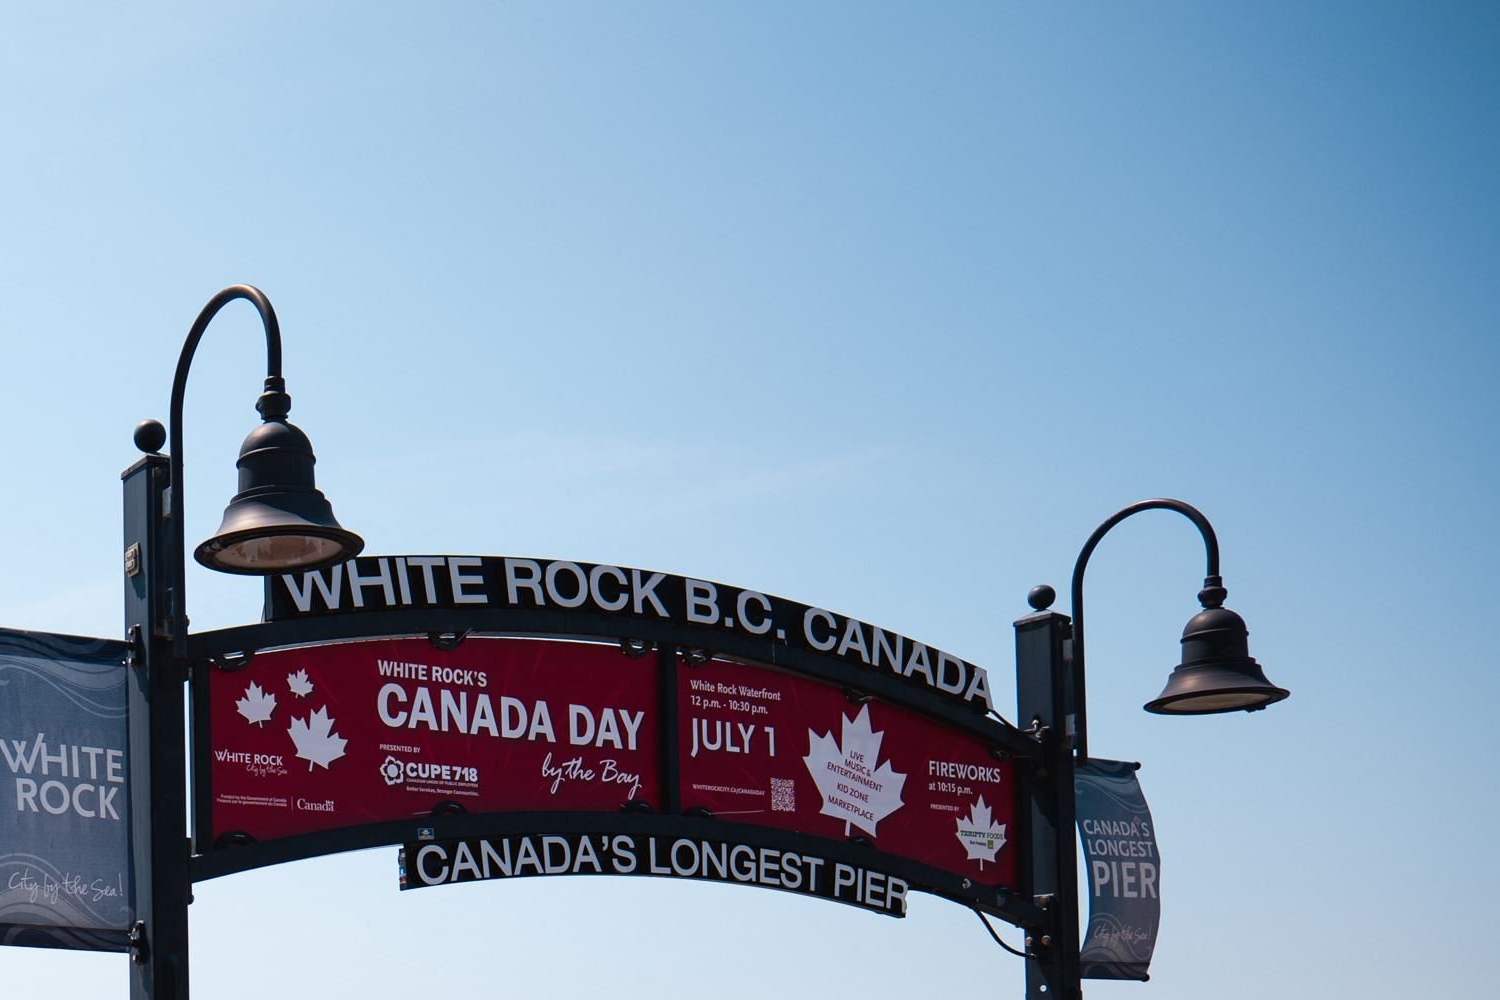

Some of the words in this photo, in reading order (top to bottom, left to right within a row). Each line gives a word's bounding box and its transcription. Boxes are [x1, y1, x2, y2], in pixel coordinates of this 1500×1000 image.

[282, 557, 489, 612] WHITE
[503, 557, 671, 618] ROCK
[685, 578, 786, 640] B.C.
[803, 607, 995, 711] CANADA
[377, 659, 428, 681] WHITE
[432, 666, 488, 688] ROCK'S
[690, 679, 716, 693] White
[717, 682, 737, 695] Rock
[738, 685, 781, 701] Waterfront
[691, 695, 701, 706] 12
[728, 699, 750, 712] 10:30
[377, 682, 557, 743] CANADA
[568, 703, 645, 751] DAY
[379, 743, 412, 753] PRESENTED
[690, 717, 756, 758] JULY
[764, 726, 775, 757] 1
[214, 748, 251, 764] WHITE
[253, 754, 283, 766] ROCK
[844, 758, 866, 774] MUSIC
[850, 750, 864, 763] LIVE
[405, 762, 451, 780] CUPE
[452, 765, 478, 782] 718
[542, 751, 566, 794] by
[562, 755, 596, 782] the
[599, 758, 643, 801] Bay
[827, 761, 883, 793] ENTERTAINMENT
[928, 760, 1001, 784] FIREWORKS
[16, 777, 120, 820] ROCK
[837, 782, 849, 794] KID
[849, 787, 869, 803] ZONE
[928, 782, 936, 791] at
[937, 781, 956, 793] 10:15
[297, 798, 335, 812] Canada
[828, 795, 875, 821] MARKETPLACE
[1083, 818, 1150, 837] CANADA'S
[1087, 838, 1154, 858] LONGEST
[416, 834, 638, 886] CANADA'S
[649, 837, 825, 892] LONGEST
[834, 862, 909, 914] PIER
[1092, 860, 1157, 899] PIER
[8, 867, 38, 904] City
[43, 872, 59, 905] by
[62, 872, 88, 895] the
[90, 872, 124, 902] Sea!
